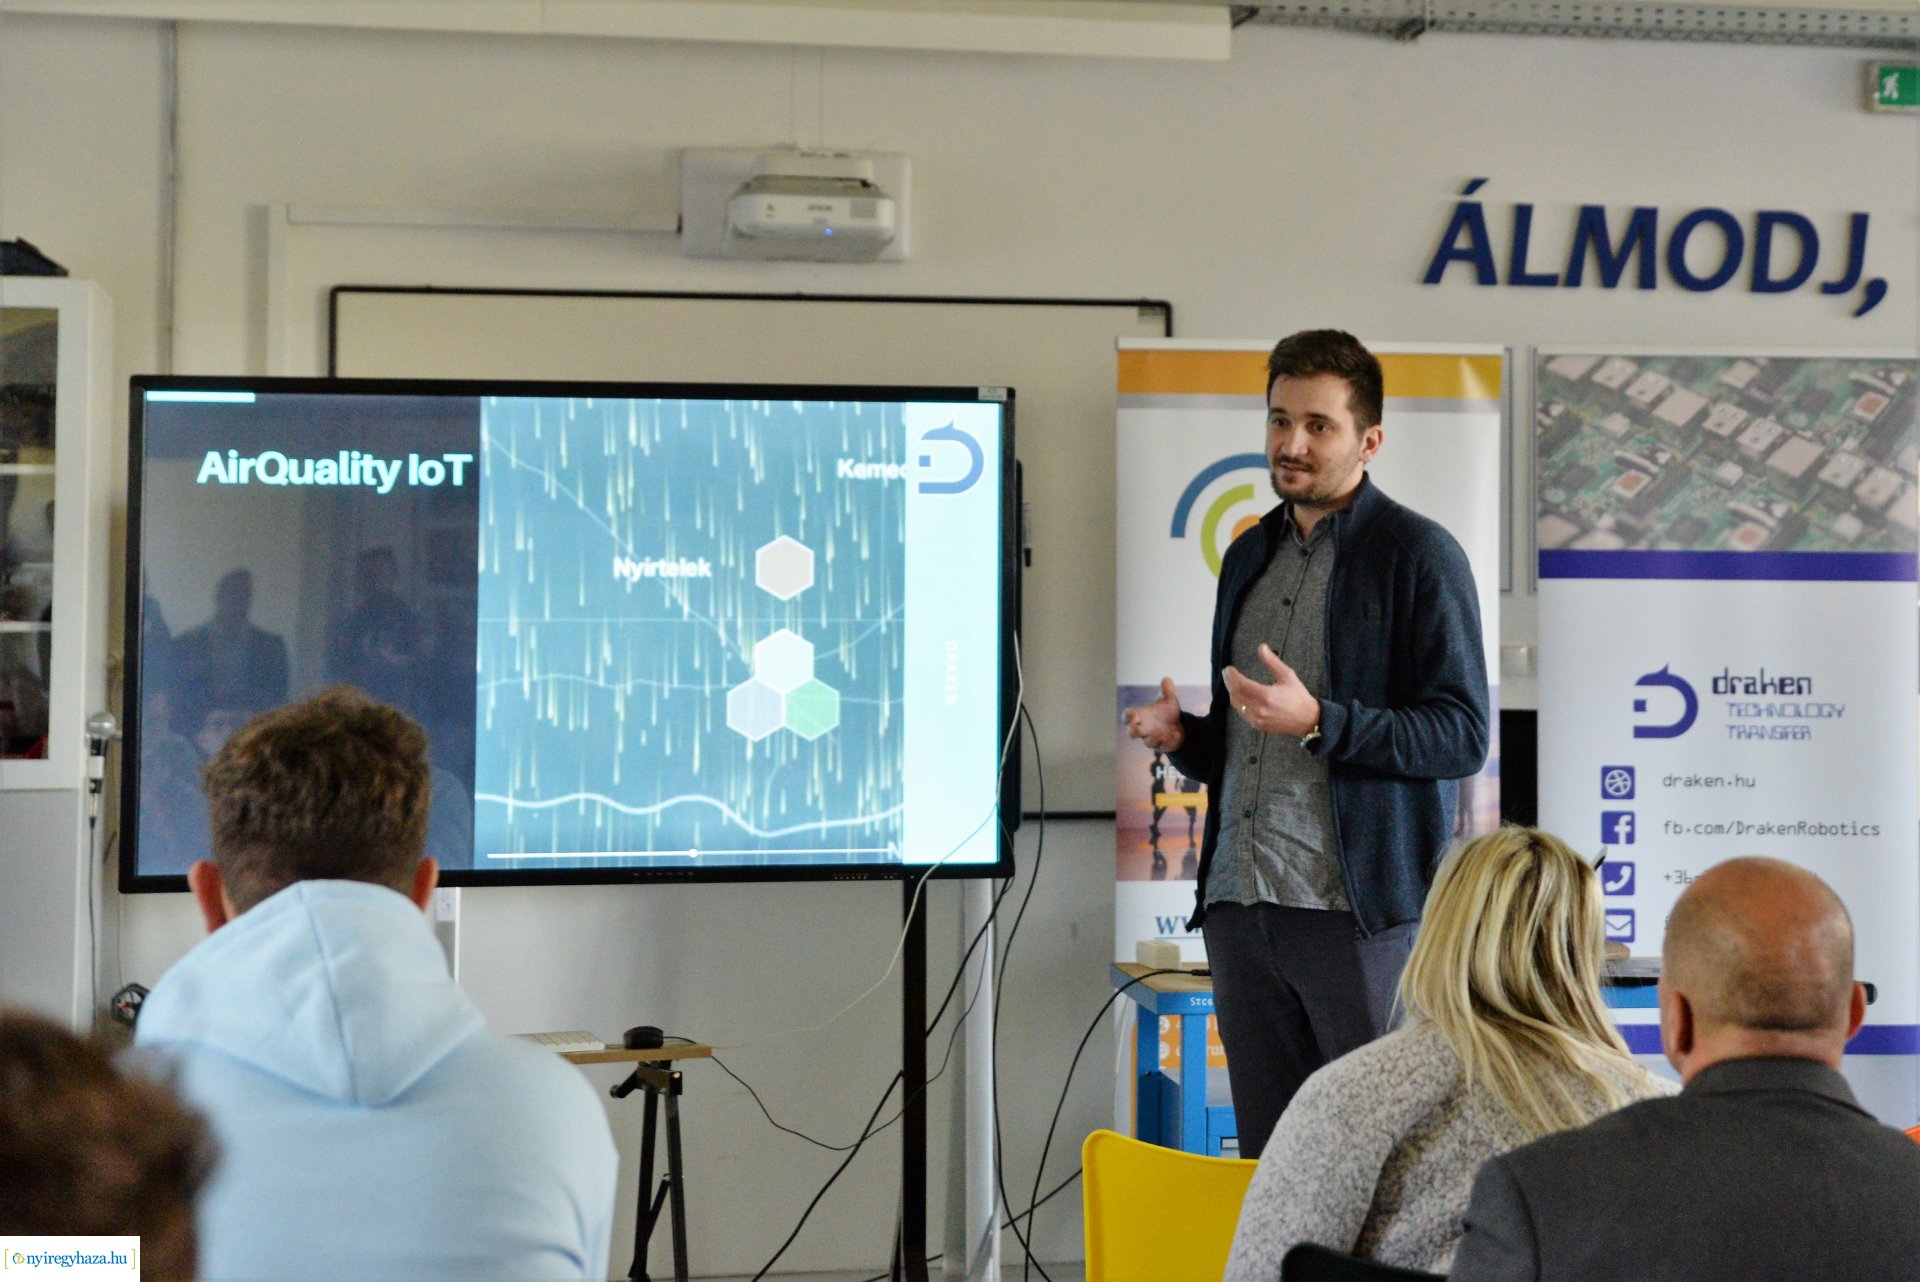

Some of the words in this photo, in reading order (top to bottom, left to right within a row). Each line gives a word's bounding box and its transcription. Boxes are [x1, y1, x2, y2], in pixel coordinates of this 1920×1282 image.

[1423, 177, 1888, 318] ÁLMODJ,
[197, 449, 402, 494] AirQuality
[409, 453, 473, 486] IoT
[1712, 667, 1812, 695] draken
[1726, 702, 1845, 718] TECHNOLOGY
[1726, 724, 1812, 740] TRANSFER
[1662, 774, 1756, 788] draken.hu
[1663, 820, 1881, 837] fb.com/DrakenRobotics
